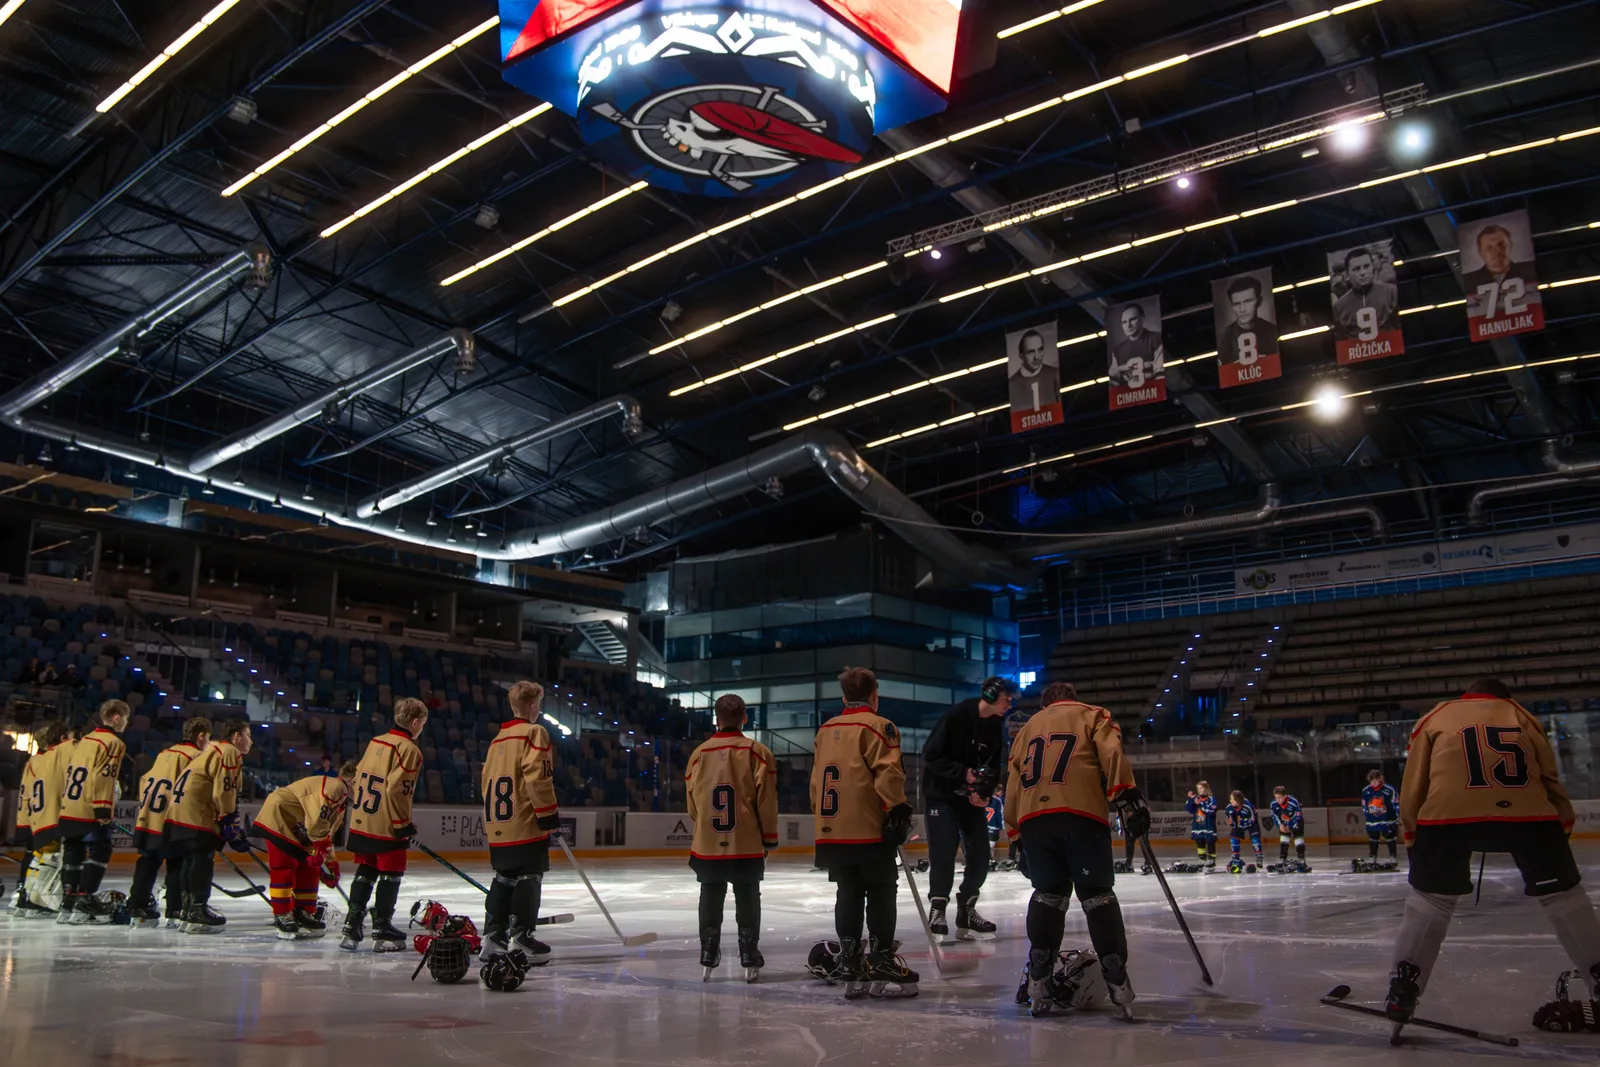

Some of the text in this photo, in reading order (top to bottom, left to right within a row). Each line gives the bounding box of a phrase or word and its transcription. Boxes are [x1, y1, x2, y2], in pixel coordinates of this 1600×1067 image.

[1476, 277, 1528, 320] 72
[1357, 306, 1379, 342] 9
[1479, 313, 1535, 337] HANULJAK
[1237, 332, 1258, 366] 8
[1126, 356, 1145, 389] 3
[1031, 381, 1040, 412] 1
[1116, 386, 1157, 406] CIMRMAN
[1021, 411, 1053, 428] STRAKA
[102, 764, 118, 777] 38
[1020, 733, 1078, 790] 97
[1460, 723, 1531, 789] 15
[223, 776, 238, 792] 84
[485, 775, 515, 823] 18
[820, 763, 841, 818] 6
[710, 783, 737, 833] 9
[460, 838, 484, 847] butik
